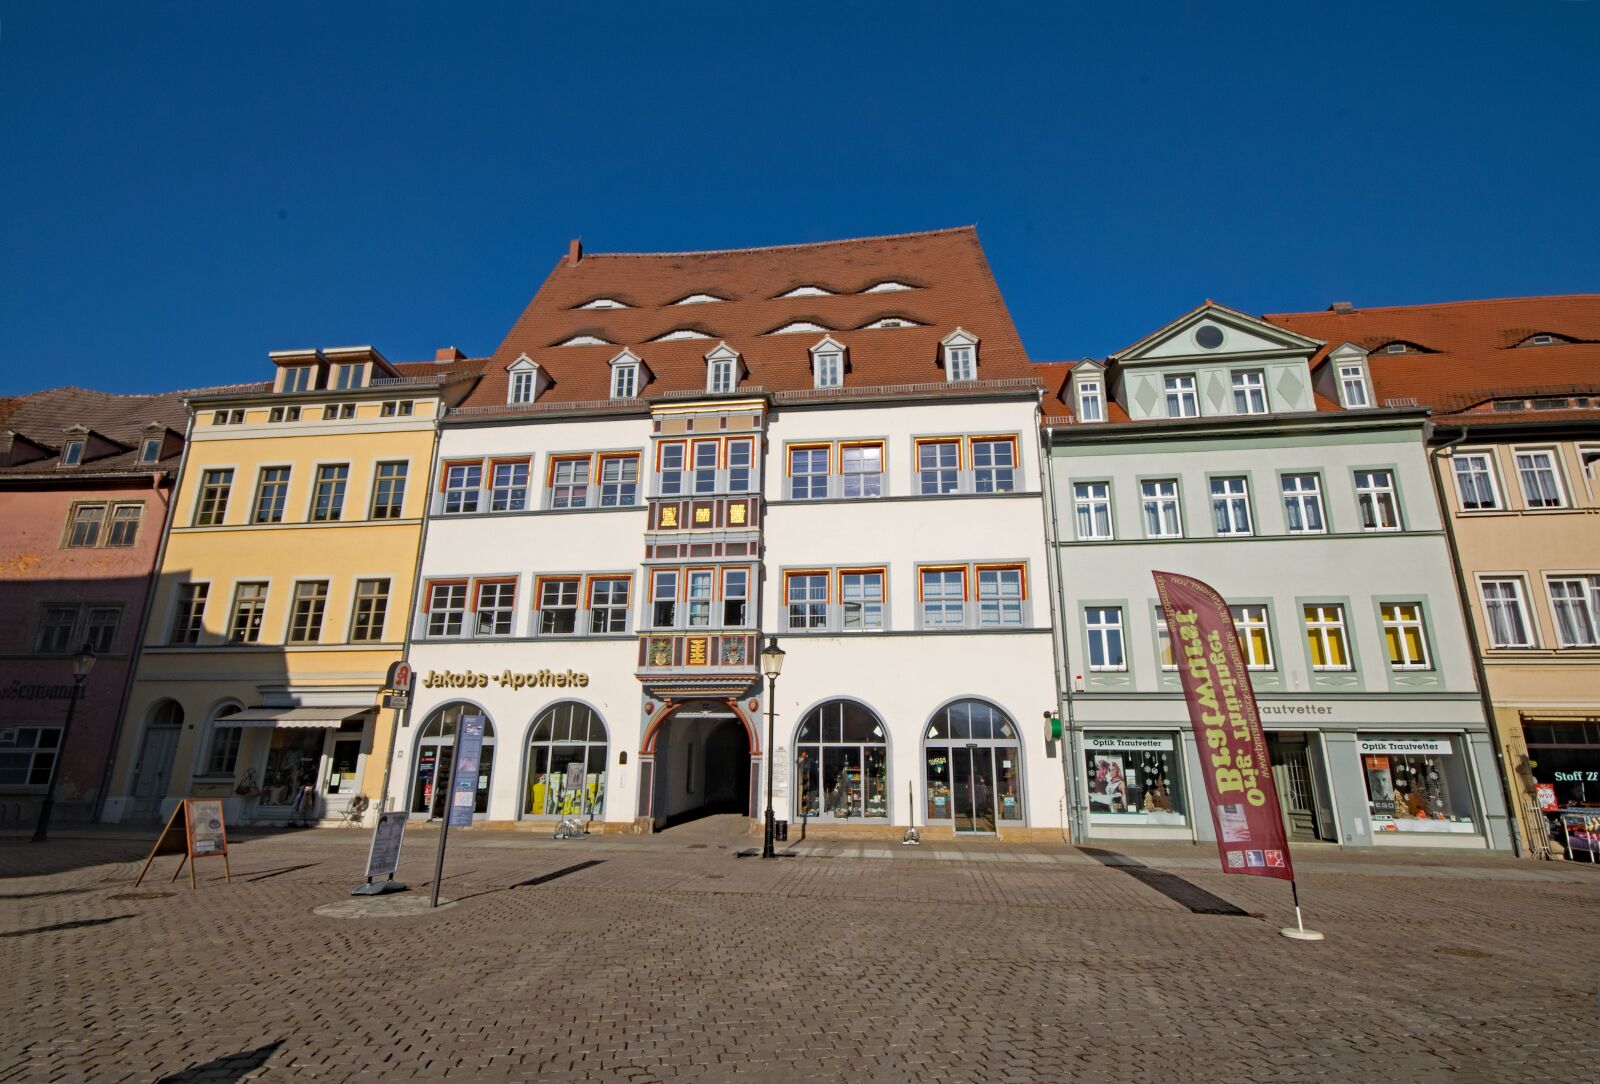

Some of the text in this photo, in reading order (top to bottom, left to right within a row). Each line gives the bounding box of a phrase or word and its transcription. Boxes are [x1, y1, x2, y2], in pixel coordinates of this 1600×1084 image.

[1093, 739, 1115, 747] Optik
[1361, 743, 1387, 751] Optik
[1554, 770, 1583, 782] Stoff
